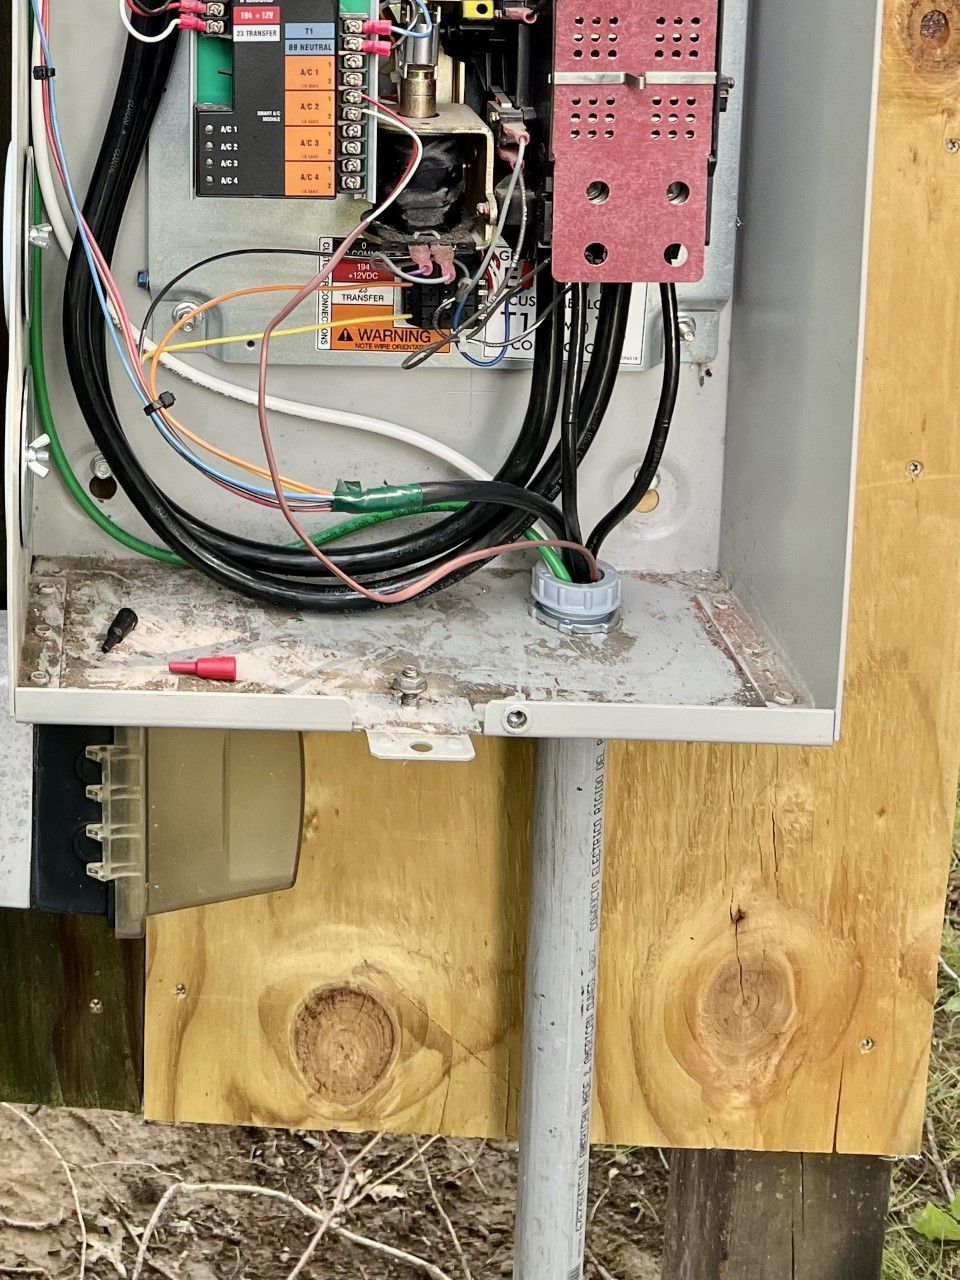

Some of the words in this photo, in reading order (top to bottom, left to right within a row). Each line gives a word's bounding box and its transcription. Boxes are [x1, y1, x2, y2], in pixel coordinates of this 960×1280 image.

[240, 11, 253, 20] 194
[246, 29, 278, 37] TRANSFER
[304, 27, 314, 35] T1
[299, 43, 332, 51] NEUTRAL
[300, 68, 313, 76] A/C
[314, 68, 320, 76] 1
[300, 102, 313, 110] A/C
[314, 102, 320, 110] 2
[220, 125, 233, 133] A/C
[233, 125, 239, 133] 1
[220, 143, 233, 151] A/C
[233, 143, 239, 151] 2
[300, 139, 313, 147] A/C
[314, 139, 320, 147] 3
[220, 159, 233, 167] A/C
[233, 159, 239, 167] 3
[220, 176, 233, 184] A/C
[233, 176, 239, 184] 4
[300, 173, 313, 181] A/C
[314, 173, 320, 181] 4
[361, 242, 367, 250] 0
[356, 263, 370, 271] 194
[348, 271, 379, 280] +12VDC
[341, 293, 385, 302] TRANSFER
[320, 290, 330, 346] CONNECONS
[357, 328, 431, 344] WARNING
[354, 342, 373, 350] NOTE
[373, 342, 391, 350] WIRE
[391, 342, 426, 351] ORIENTAT
[596, 749, 606, 771] DEL
[594, 773, 605, 816] RIGIDO
[591, 818, 603, 878] ELECTRICO
[584, 1015, 594, 1065] AMERICAN
